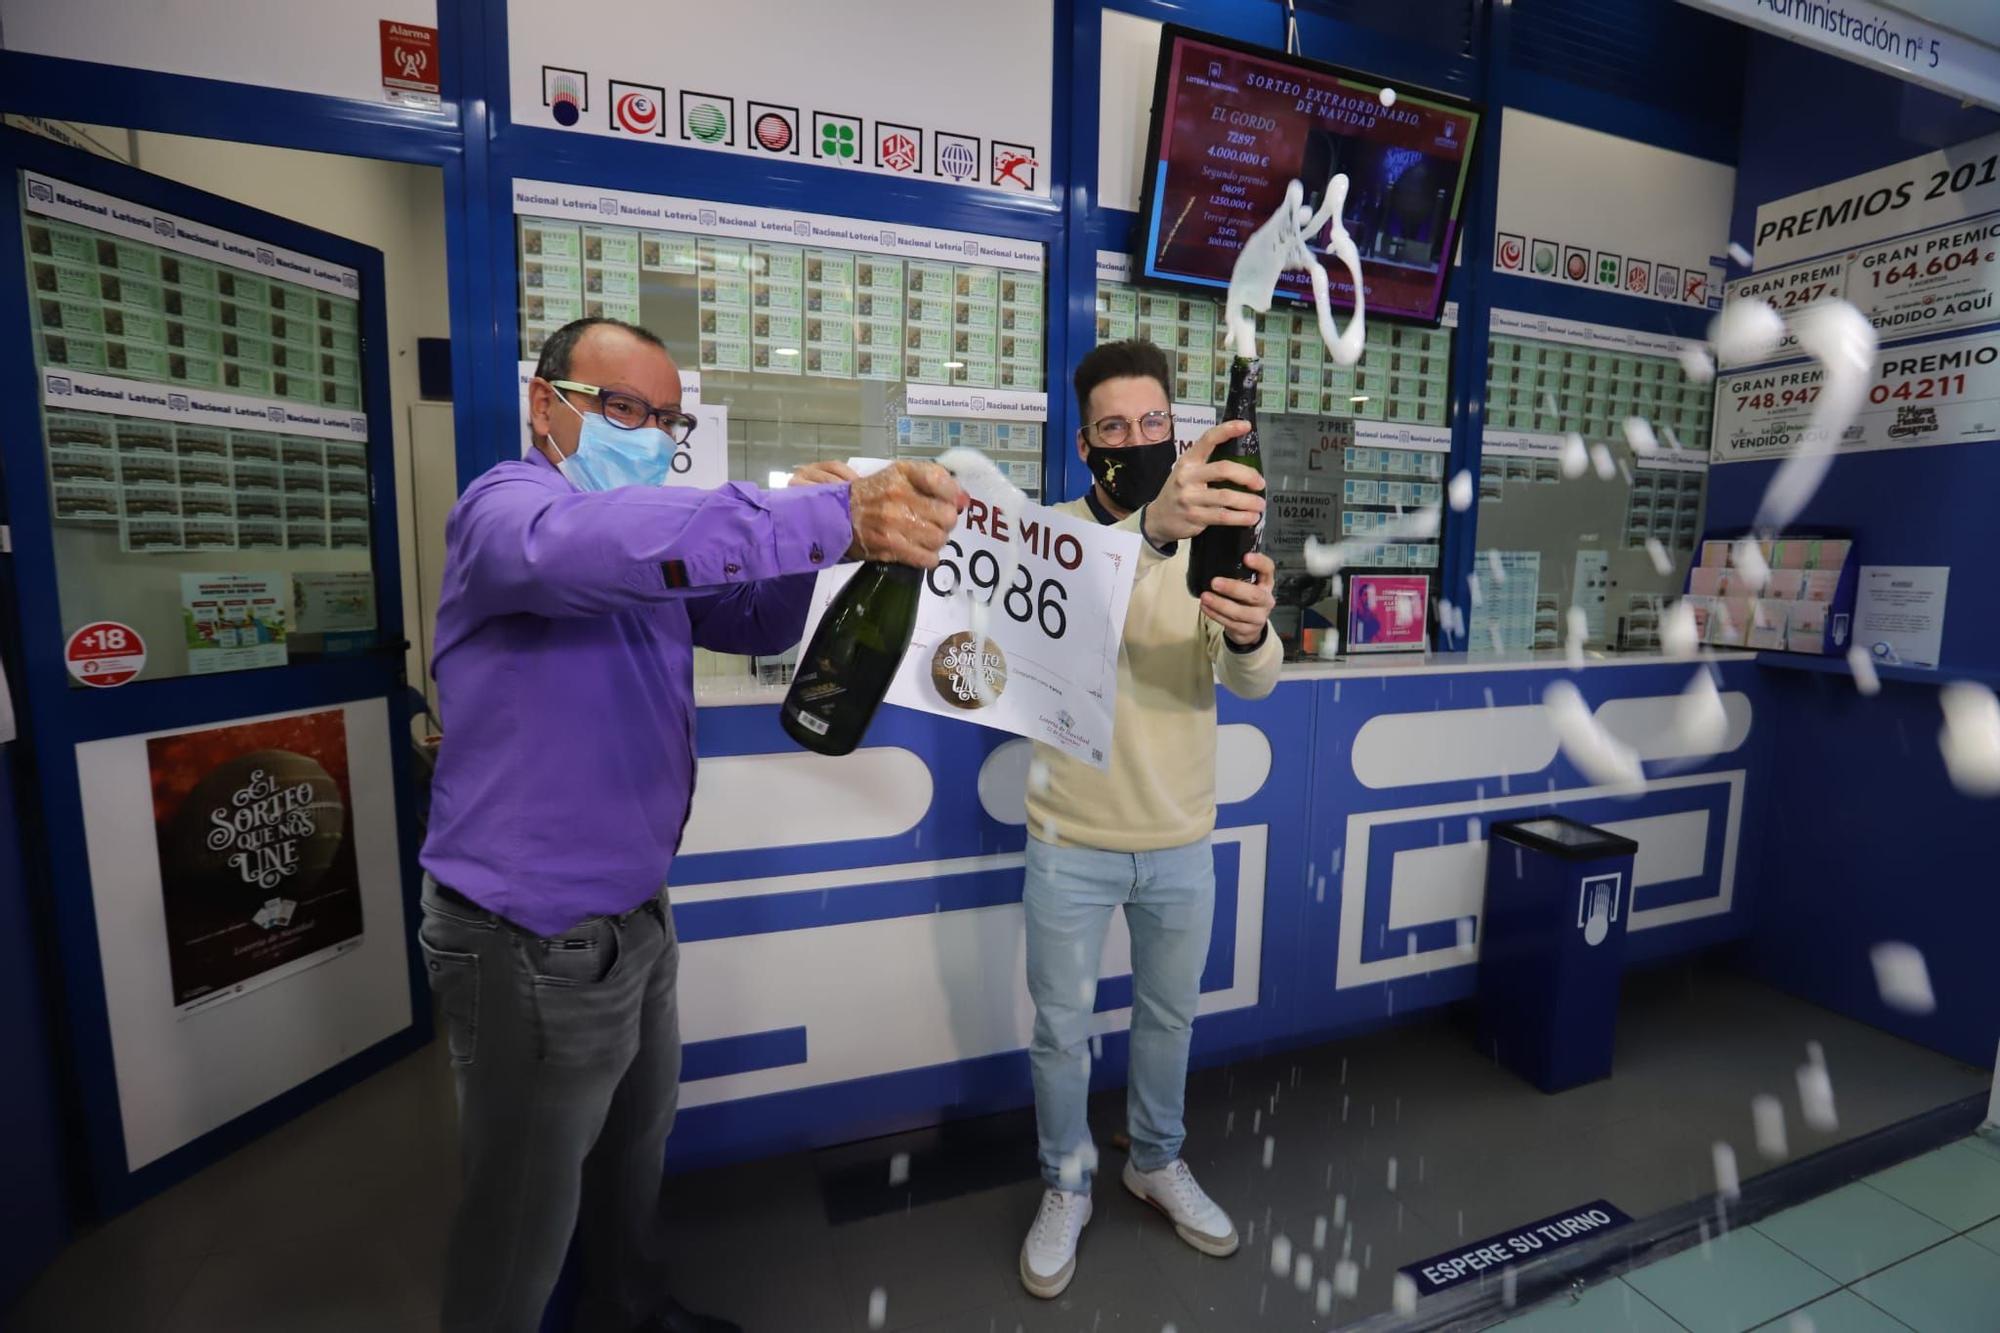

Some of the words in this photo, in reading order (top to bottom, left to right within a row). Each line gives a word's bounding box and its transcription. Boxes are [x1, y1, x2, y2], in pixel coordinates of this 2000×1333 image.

[389, 25, 431, 40] Alarma
[1929, 40, 1940, 68] 5
[1247, 73, 1300, 97] SORTEO
[1305, 88, 1420, 126] EXTRAORDINARIO
[1211, 106, 1227, 122] EL
[1230, 111, 1276, 132] GORDO
[1295, 100, 1314, 114] DE
[1318, 106, 1377, 129] NAVIDAD
[1226, 131, 1257, 146] 72897
[1207, 144, 1259, 166] 4.000.000
[1261, 156, 1270, 168] €
[1202, 165, 1238, 180] Segundo
[1238, 174, 1269, 186] premio
[516, 193, 558, 206] Nacional
[620, 205, 661, 218] Nacional
[719, 216, 757, 228] Nacional
[812, 227, 848, 239] Nacional
[897, 237, 931, 249] Nacional
[980, 247, 1012, 258] Nacional
[1757, 180, 1915, 247] PREMIOS
[1863, 245, 1919, 269] GRAN
[1871, 247, 1979, 289] 164.604
[1984, 252, 1996, 263] €
[1740, 278, 1785, 298] GRAN
[1790, 264, 1841, 286] PREMI
[1829, 288, 1839, 298] €
[1868, 307, 1937, 328] ENDIDO
[1943, 292, 1994, 317] AQUÍ
[1882, 346, 1998, 378] PREMIO
[75, 384, 123, 400] Nacional
[1732, 376, 1775, 394] GRAN
[1736, 386, 1822, 412] 748.947
[1869, 373, 1965, 405] 04211
[908, 396, 941, 406] Nacional
[986, 402, 1018, 411] Nacional
[1317, 420, 1325, 432] 2
[1731, 434, 1790, 449] VENDIDO
[1276, 506, 1321, 519] 162.041
[947, 495, 1084, 571] REMIO
[81, 629, 127, 650] +18
[232, 769, 280, 806] EL
[207, 783, 313, 850] SORTEO
[237, 826, 274, 851] QUE
[279, 807, 316, 838] NOS
[228, 839, 299, 889] UNE
[1422, 1243, 1514, 1285] ESPERE
[1508, 1232, 1543, 1254] SU
[1537, 1209, 1611, 1242] TURNO
